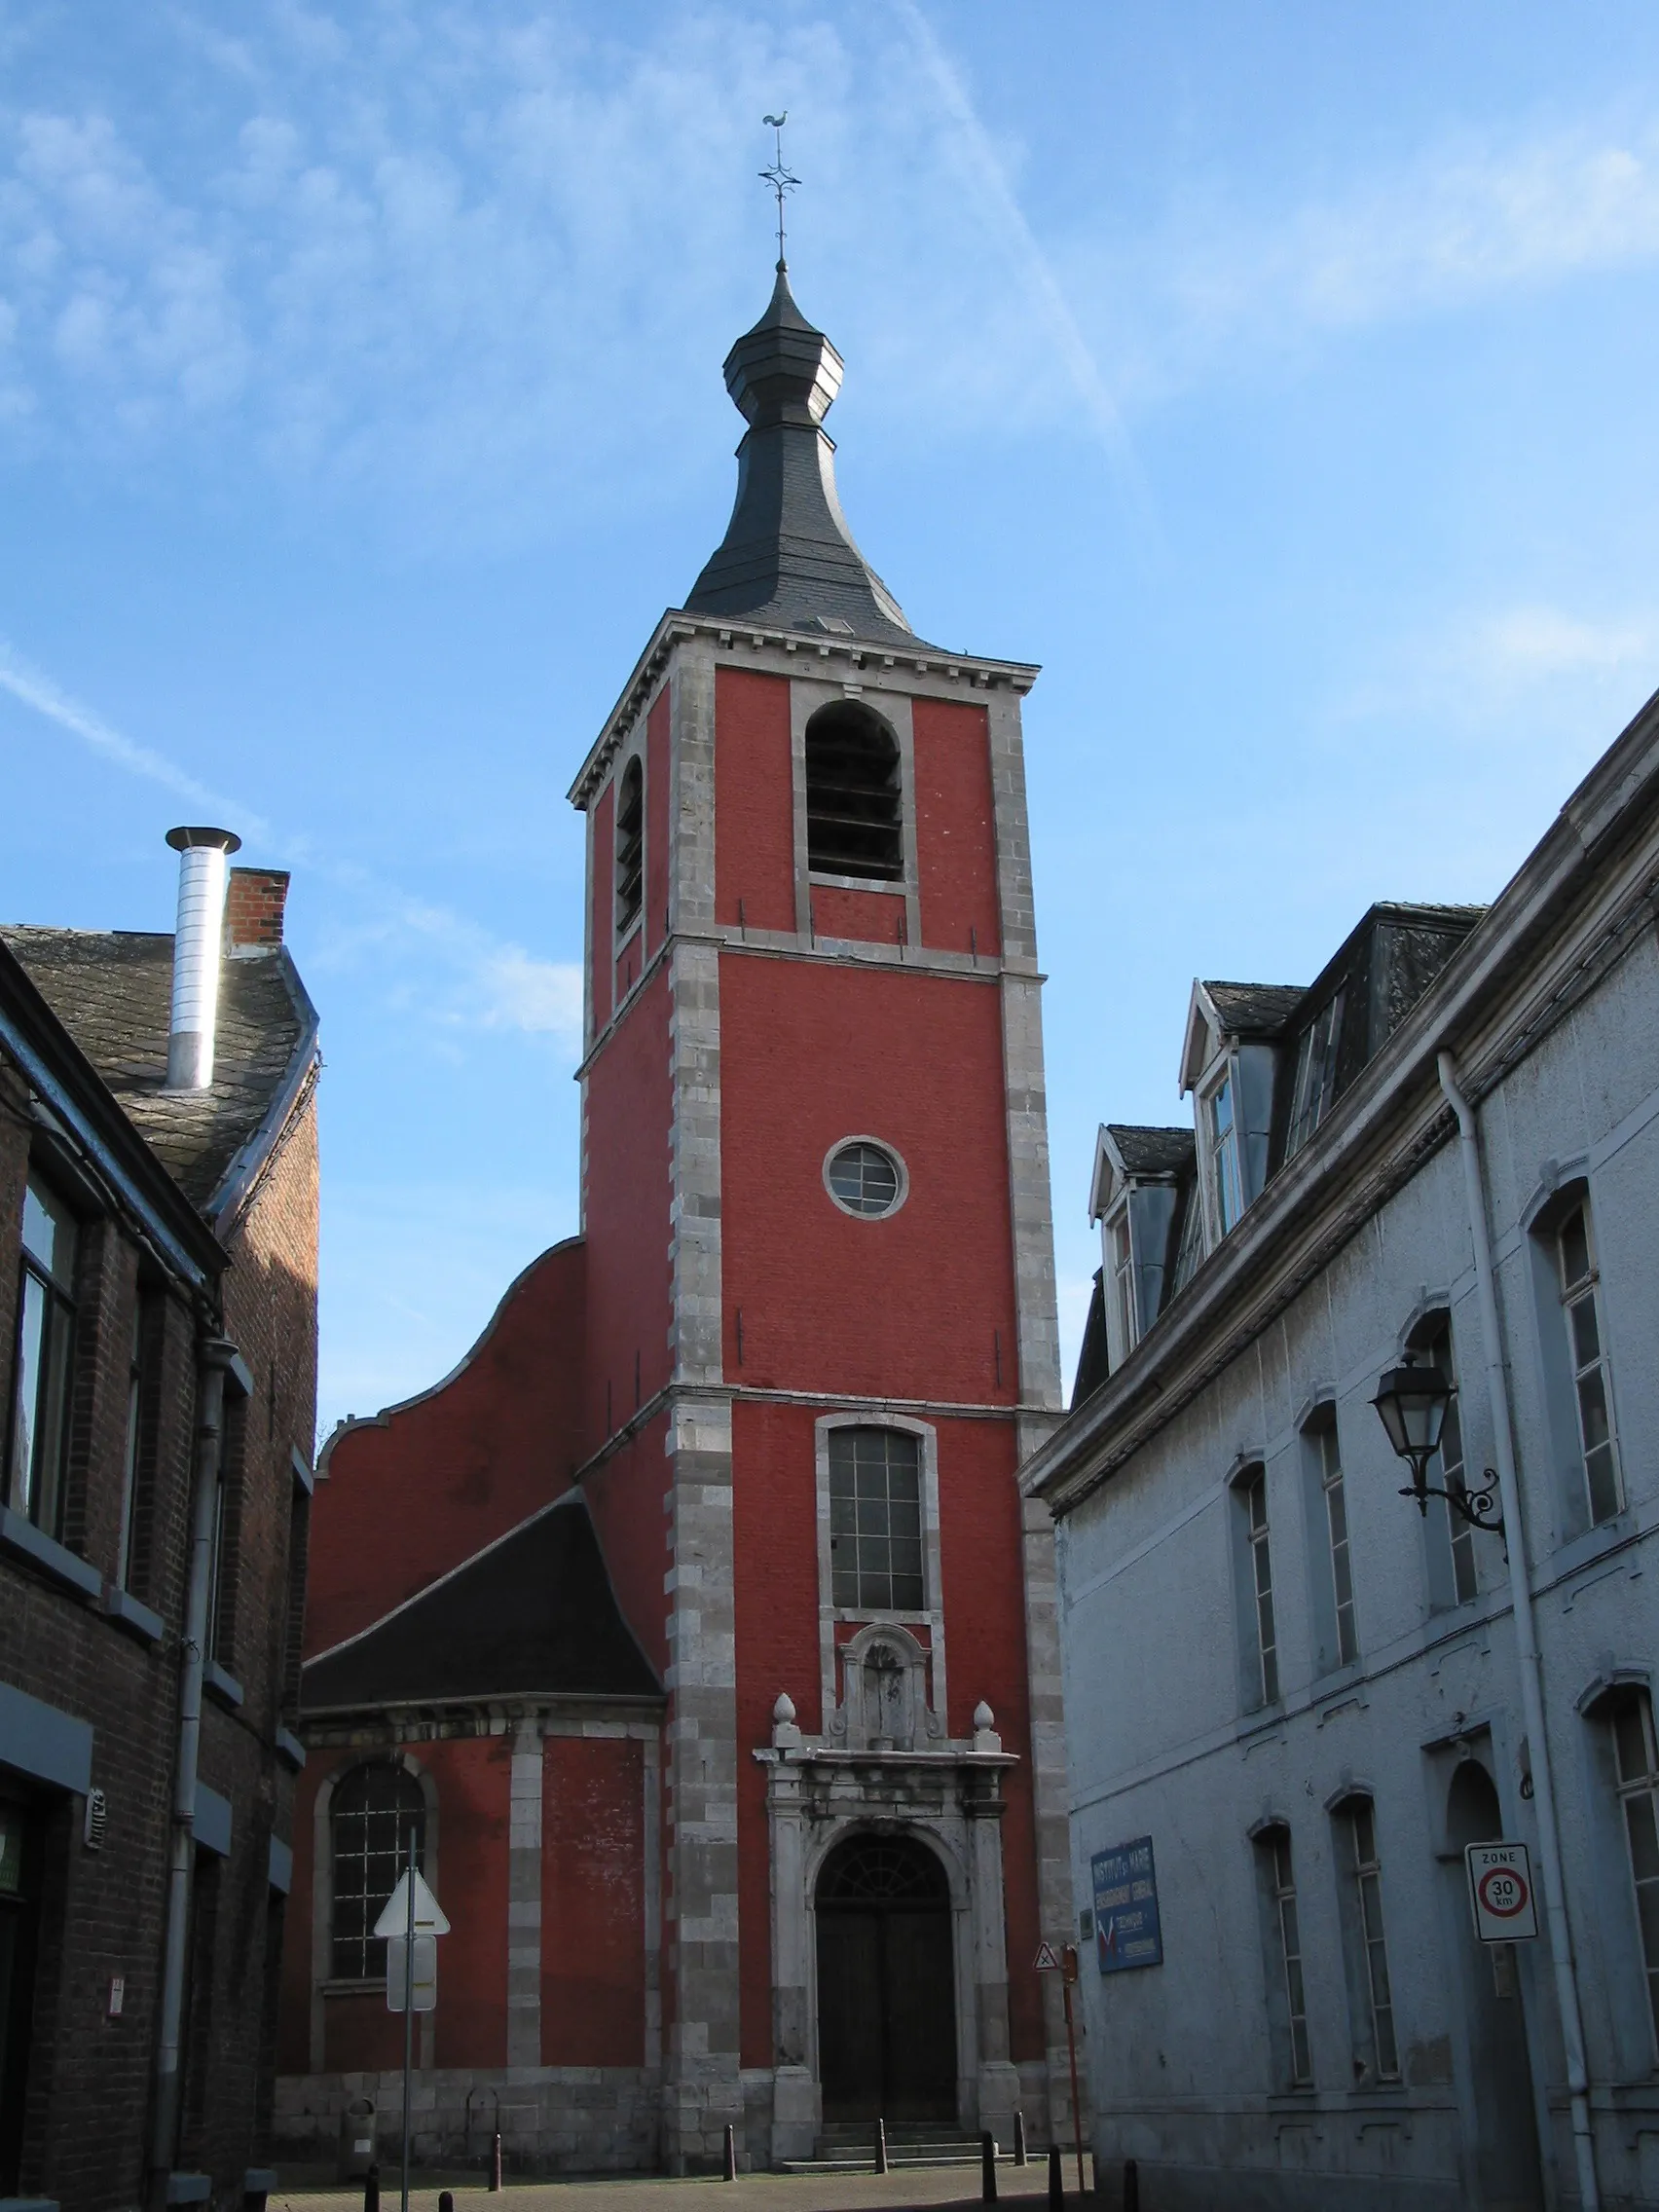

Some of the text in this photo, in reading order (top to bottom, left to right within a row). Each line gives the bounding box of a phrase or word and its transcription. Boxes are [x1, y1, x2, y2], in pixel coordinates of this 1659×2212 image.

[1482, 1852, 1516, 1863] ZONE
[1093, 1856, 1122, 1885] INSTITUT
[1492, 1880, 1513, 1896] 30
[1495, 1897, 1513, 1905] km
